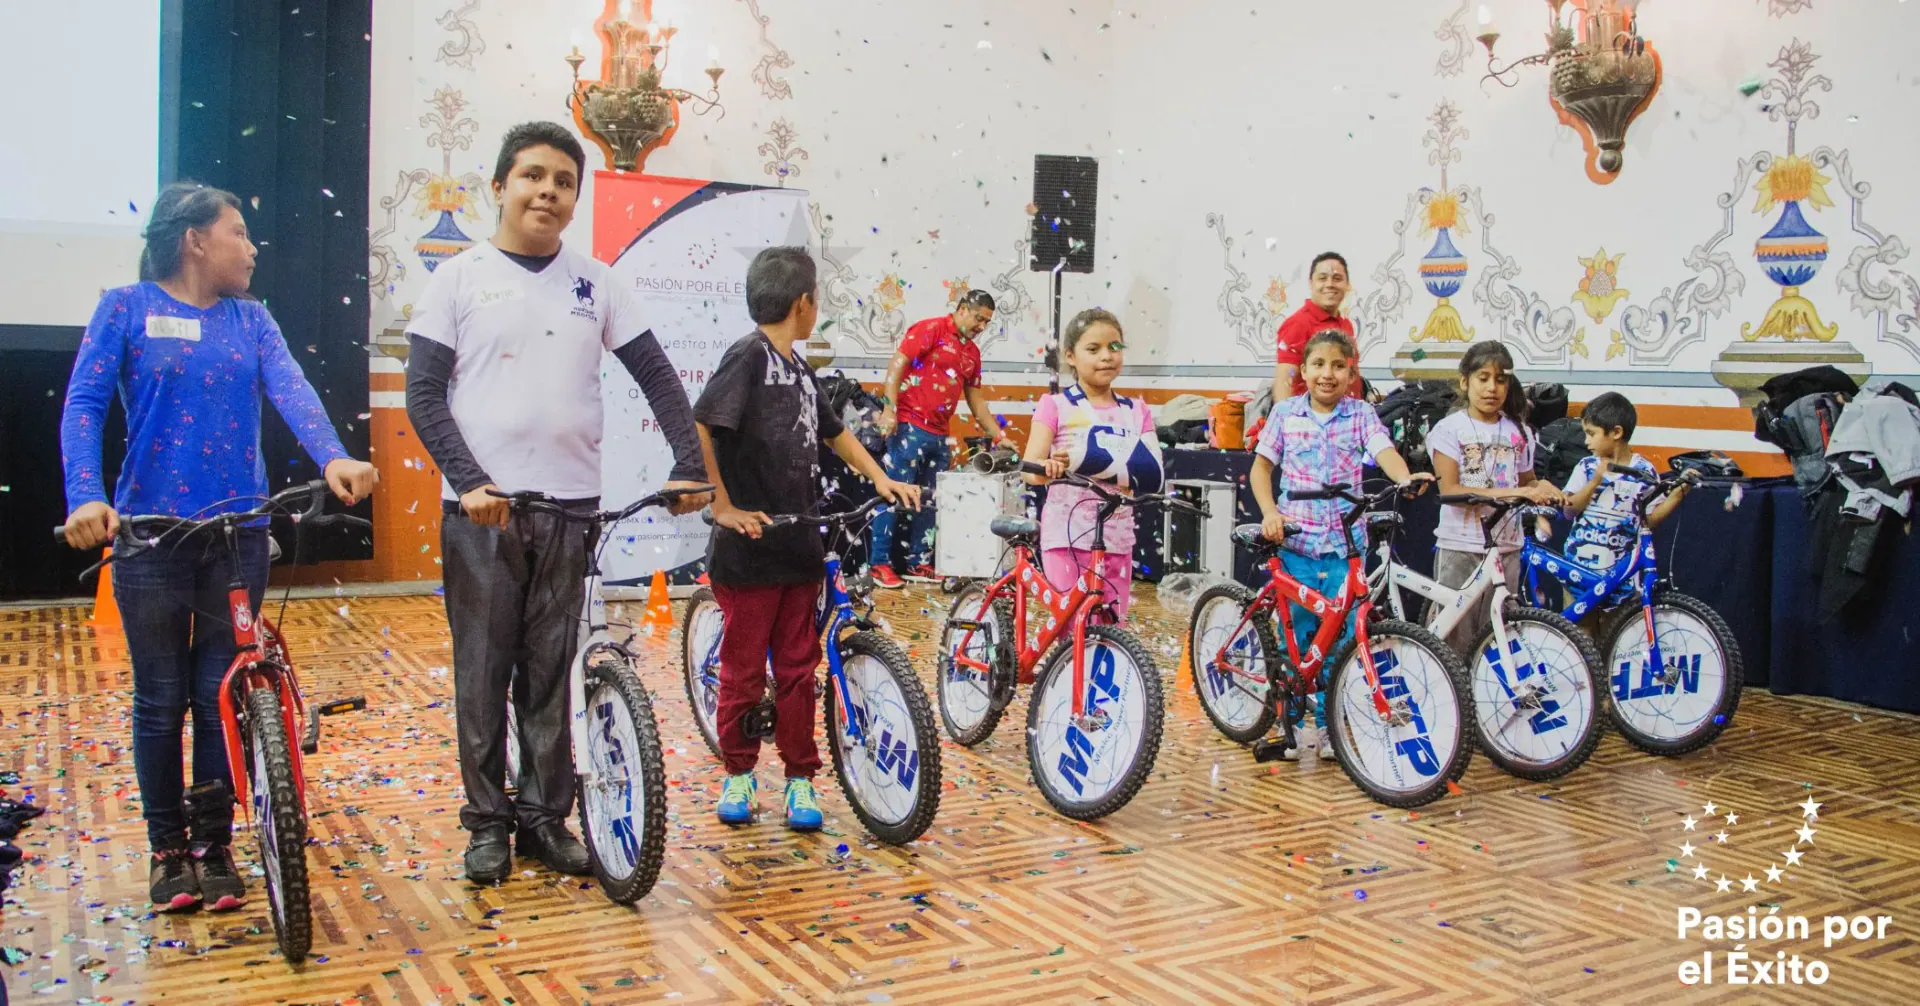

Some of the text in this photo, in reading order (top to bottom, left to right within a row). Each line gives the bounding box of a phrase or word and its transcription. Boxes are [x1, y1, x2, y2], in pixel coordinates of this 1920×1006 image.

[636, 276, 682, 290] PASIÓN
[686, 280, 713, 292] POR
[716, 282, 731, 293] EL
[1575, 528, 1628, 548] adidas
[1356, 648, 1440, 777] MTP
